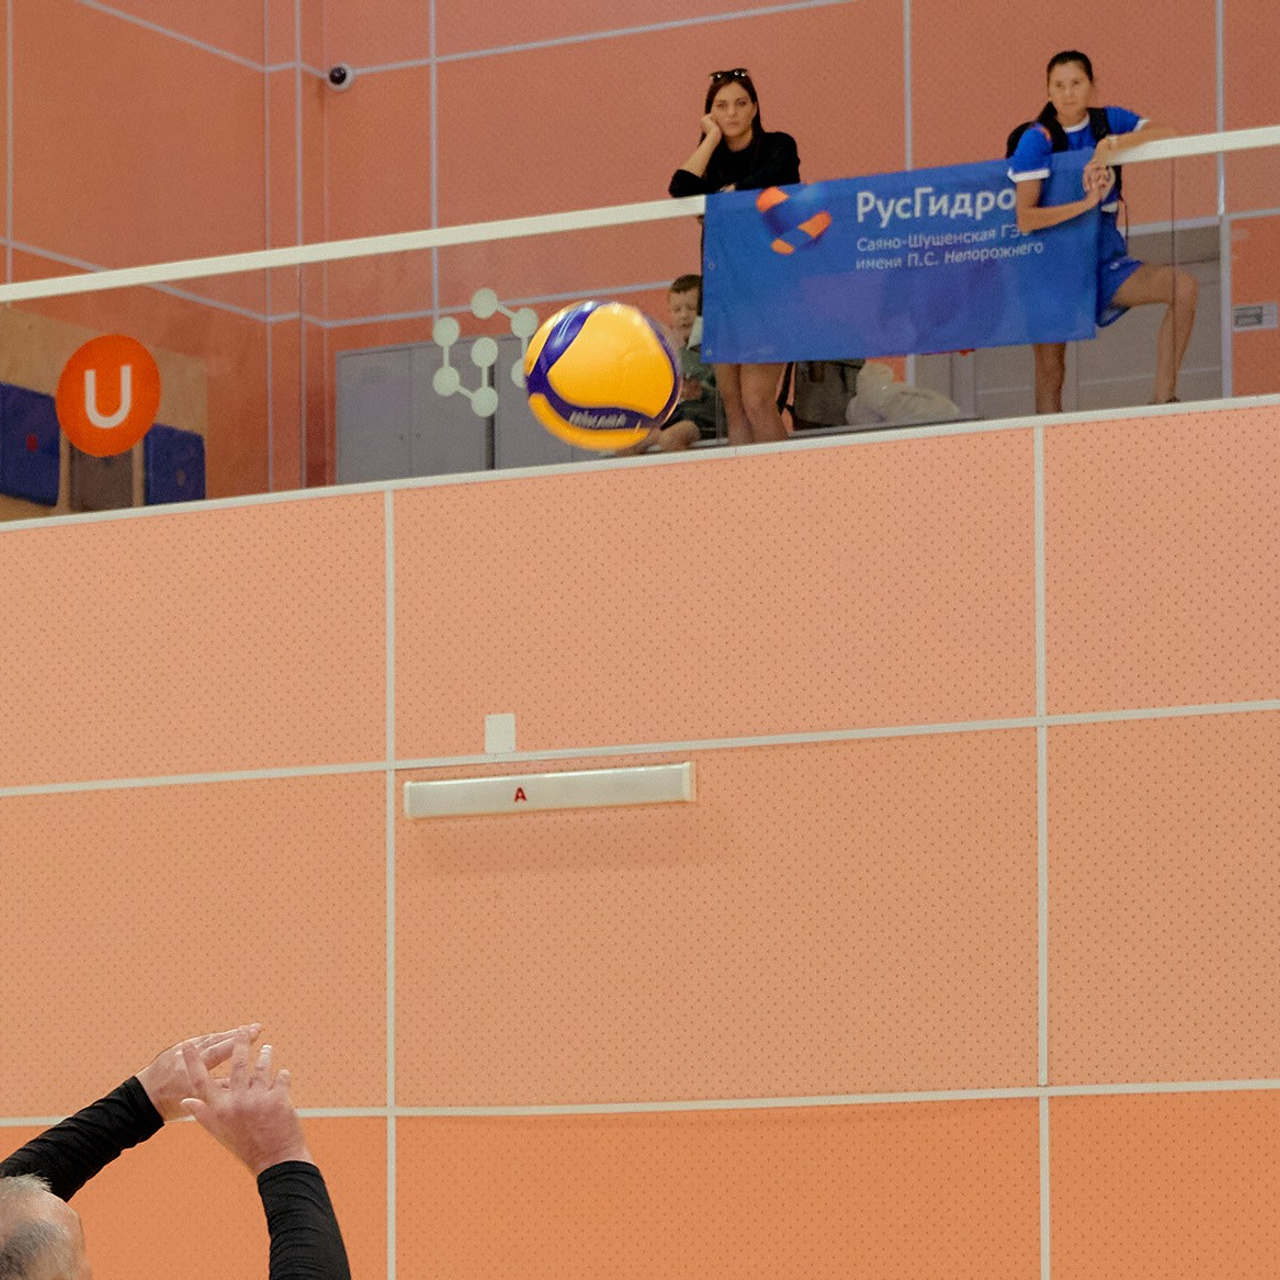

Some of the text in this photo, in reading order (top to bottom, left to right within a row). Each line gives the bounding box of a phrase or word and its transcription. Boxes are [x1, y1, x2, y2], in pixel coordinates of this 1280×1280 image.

[856, 186, 1017, 228] РусГидро
[857, 228, 996, 252] Саяно-Шушенская
[855, 241, 1045, 270] имени П.С. Непорожнего
